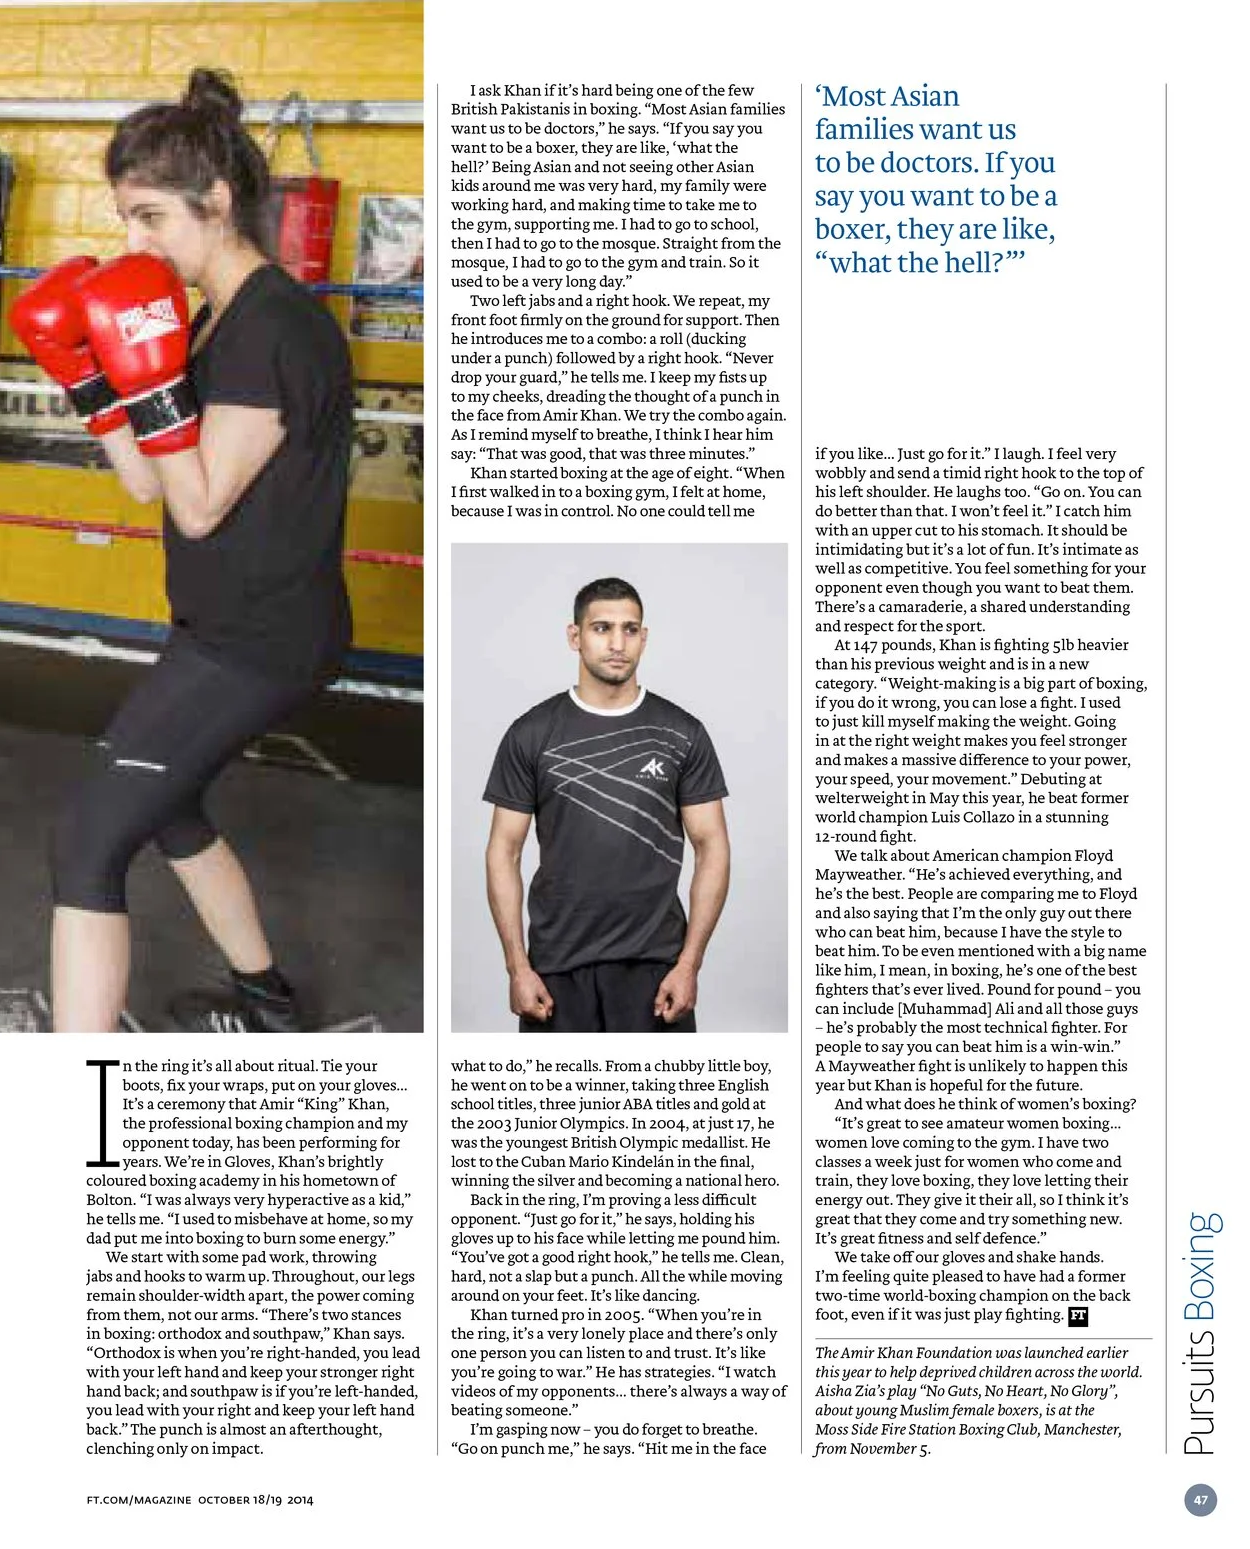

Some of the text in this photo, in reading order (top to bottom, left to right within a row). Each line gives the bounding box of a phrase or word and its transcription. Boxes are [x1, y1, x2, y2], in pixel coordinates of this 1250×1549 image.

[815, 82, 960, 106] ‘Most Asian
[450, 101, 785, 118] British Pakistanis in boxing. “Most Asian families
[815, 115, 1016, 140] families want us
[814, 150, 1056, 180] to be doctors. If you
[815, 183, 1058, 213] say you want to be a
[814, 215, 1055, 247] boxer, they are like,
[815, 250, 892, 273] “what
[896, 250, 938, 273] the
[122, 1115, 408, 1132] the professional boxing champion and my
[450, 1134, 770, 1152] was the youngest British Olympic medallist. He
[814, 1287, 1131, 1305] two-time world-boxing champion on the back
[1181, 1210, 1225, 1456] Pursuits Boxing
[814, 1422, 1121, 1438] Moss Side Fire Station Boxing Club, Manchester,
[86, 1493, 314, 1506] FT.COM/MAGAZINE OCTOBER 18/19 2014
[1192, 1494, 1209, 1505] 47
